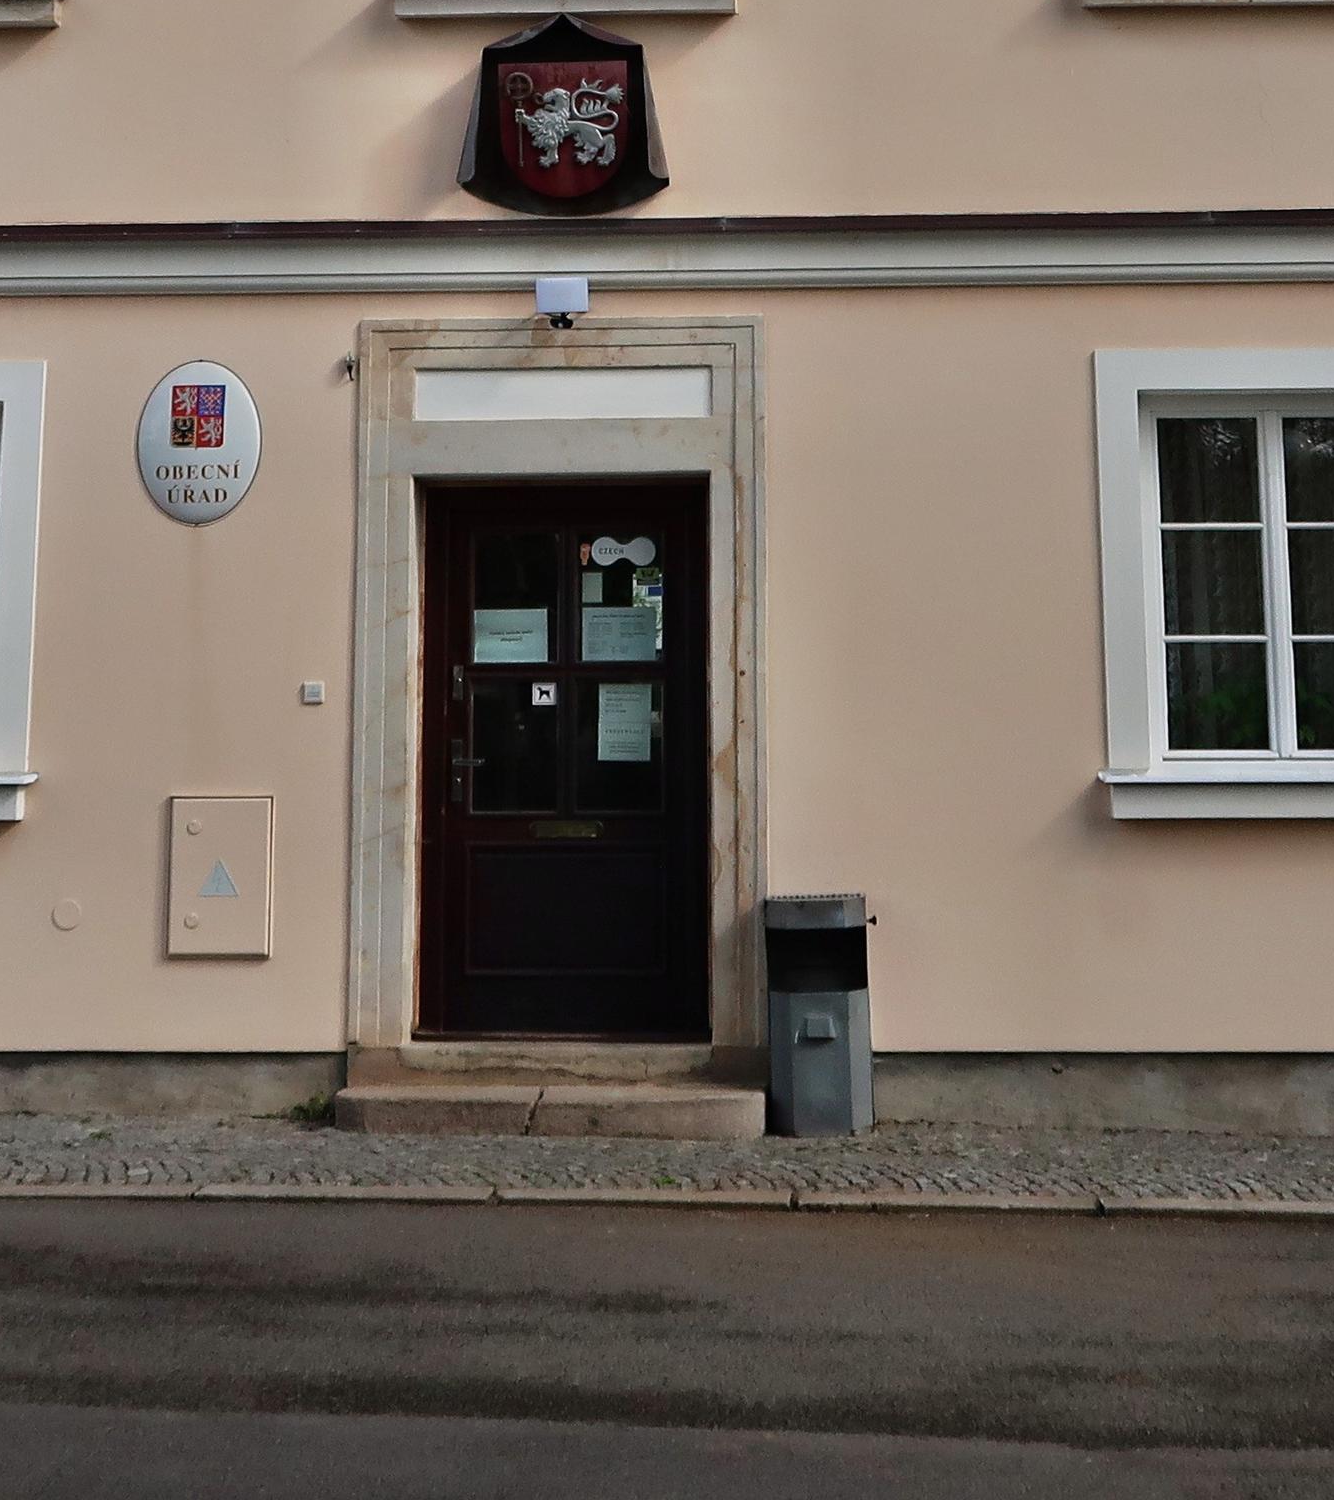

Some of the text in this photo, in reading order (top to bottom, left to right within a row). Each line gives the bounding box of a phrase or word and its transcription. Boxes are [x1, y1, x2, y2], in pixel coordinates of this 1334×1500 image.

[156, 460, 241, 481] OBECNÍ
[167, 484, 228, 504] ÚŘAD
[598, 547, 624, 555] CZECH
